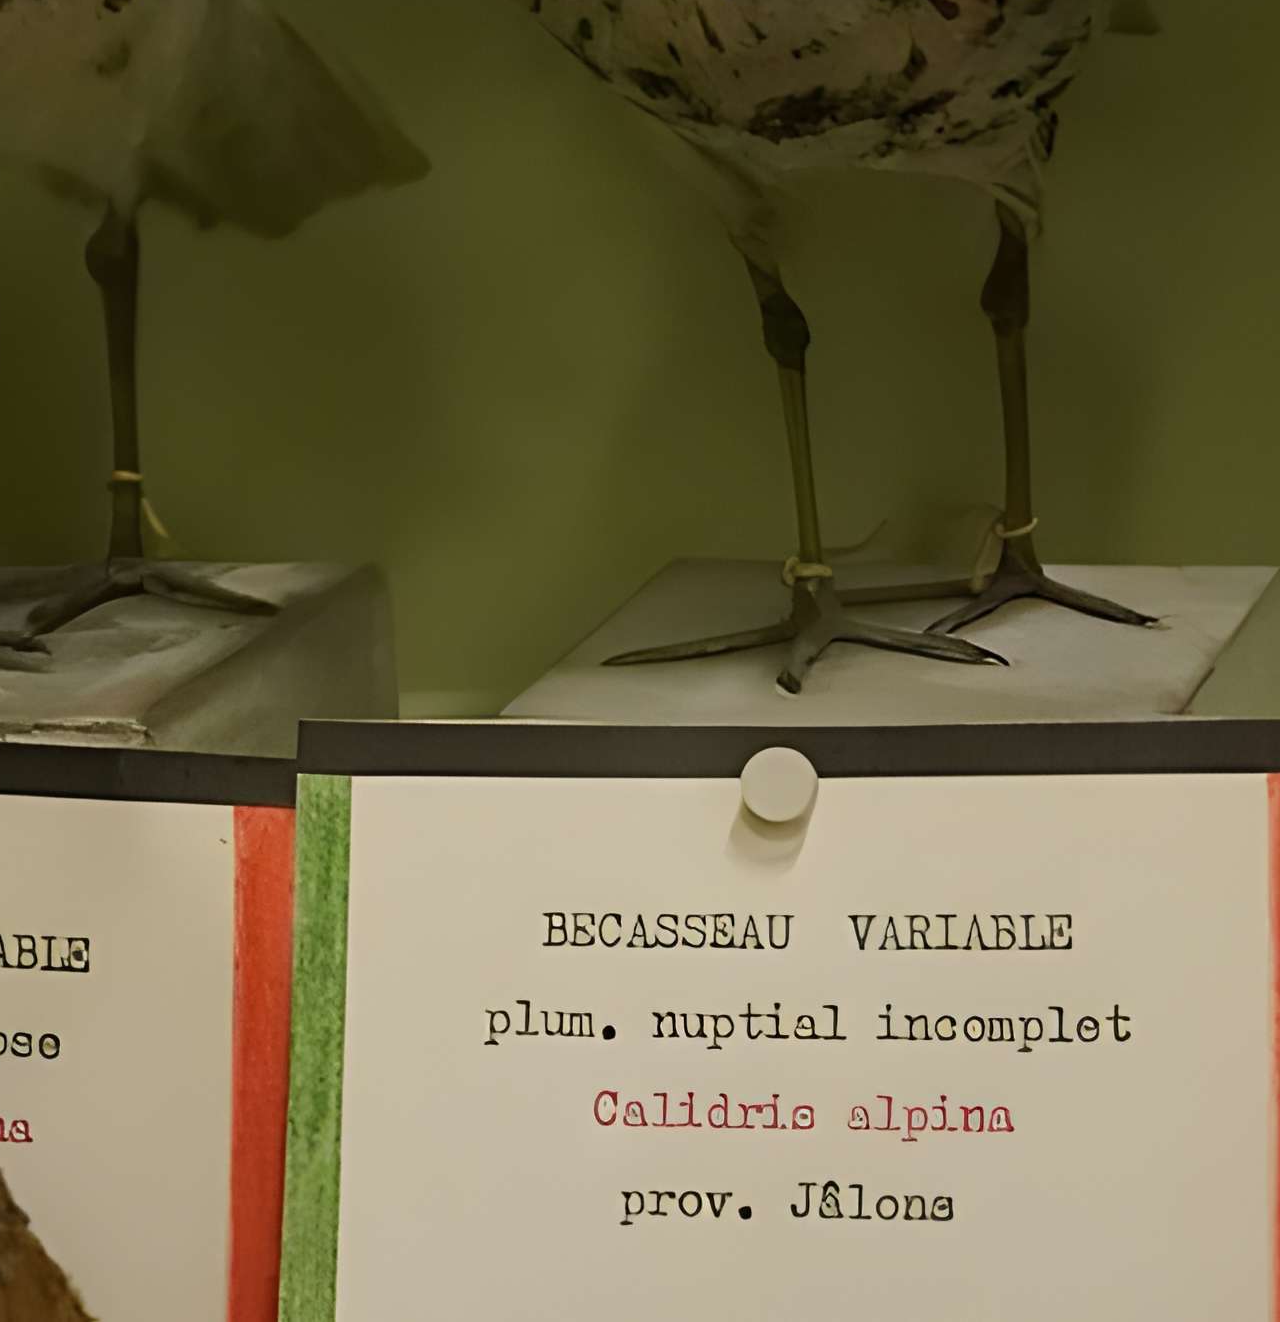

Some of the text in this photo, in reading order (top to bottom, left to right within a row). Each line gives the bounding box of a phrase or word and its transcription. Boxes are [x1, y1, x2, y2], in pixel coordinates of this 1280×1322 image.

[542, 912, 1073, 951] BECASSEAU VARIABLE
[484, 1000, 1131, 1053] plum. nuptial incomplet
[594, 1090, 1015, 1142] Calidris alpina
[619, 1190, 752, 1228] prov.
